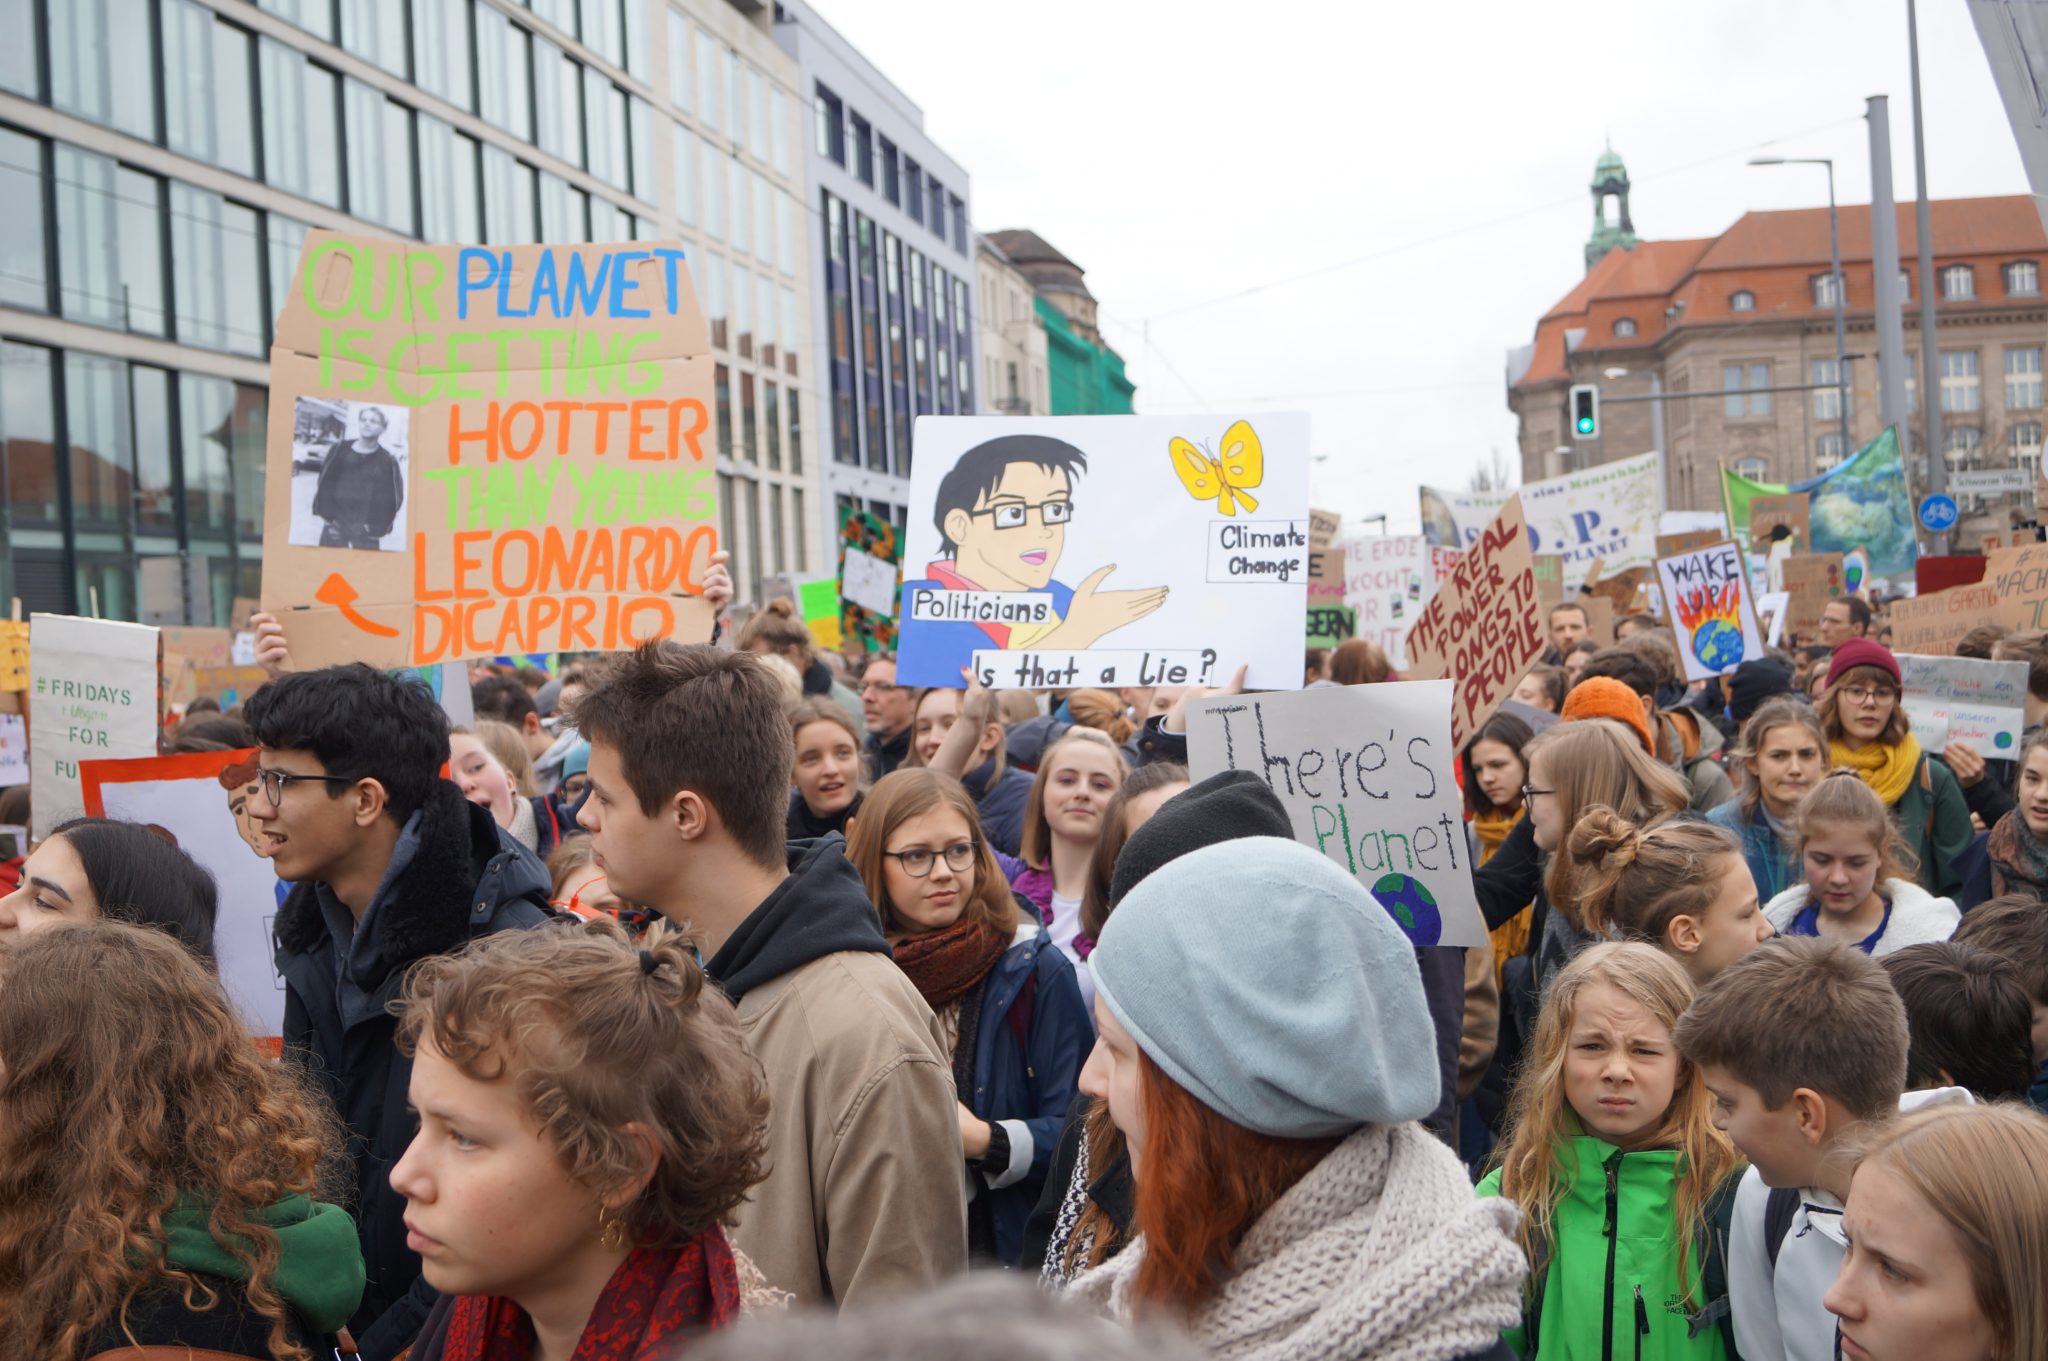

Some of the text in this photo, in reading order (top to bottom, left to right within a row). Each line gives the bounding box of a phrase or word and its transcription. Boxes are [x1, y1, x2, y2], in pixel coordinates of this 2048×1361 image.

[304, 240, 687, 323] OUR PLANET
[319, 327, 664, 407] IS GETTING
[448, 398, 709, 465] HOTTER
[424, 457, 717, 530] THAN YOUNG
[414, 526, 717, 600] LEONARDO
[1220, 524, 1305, 550] Climate
[1228, 555, 1301, 581] Change
[1372, 538, 1419, 561] ERDE
[1563, 536, 1629, 563] PLANET
[1667, 550, 1739, 584] WAKE
[914, 589, 1047, 622] Politicians
[1405, 517, 1519, 664] THE REAL
[1436, 563, 1504, 660] POWER
[1440, 596, 1511, 682] ONGS
[1508, 567, 1534, 614] TO
[1687, 584, 1720, 612] UP
[414, 596, 675, 665] DICAPRIO
[974, 654, 995, 687] Is
[1014, 654, 1079, 685] that
[1100, 667, 1116, 683] a
[1462, 602, 1544, 729] PEOPLE
[68, 726, 109, 748] FOR
[1205, 702, 1436, 799] There's
[1953, 711, 1998, 724] unseren
[1312, 803, 1457, 876] Planet
